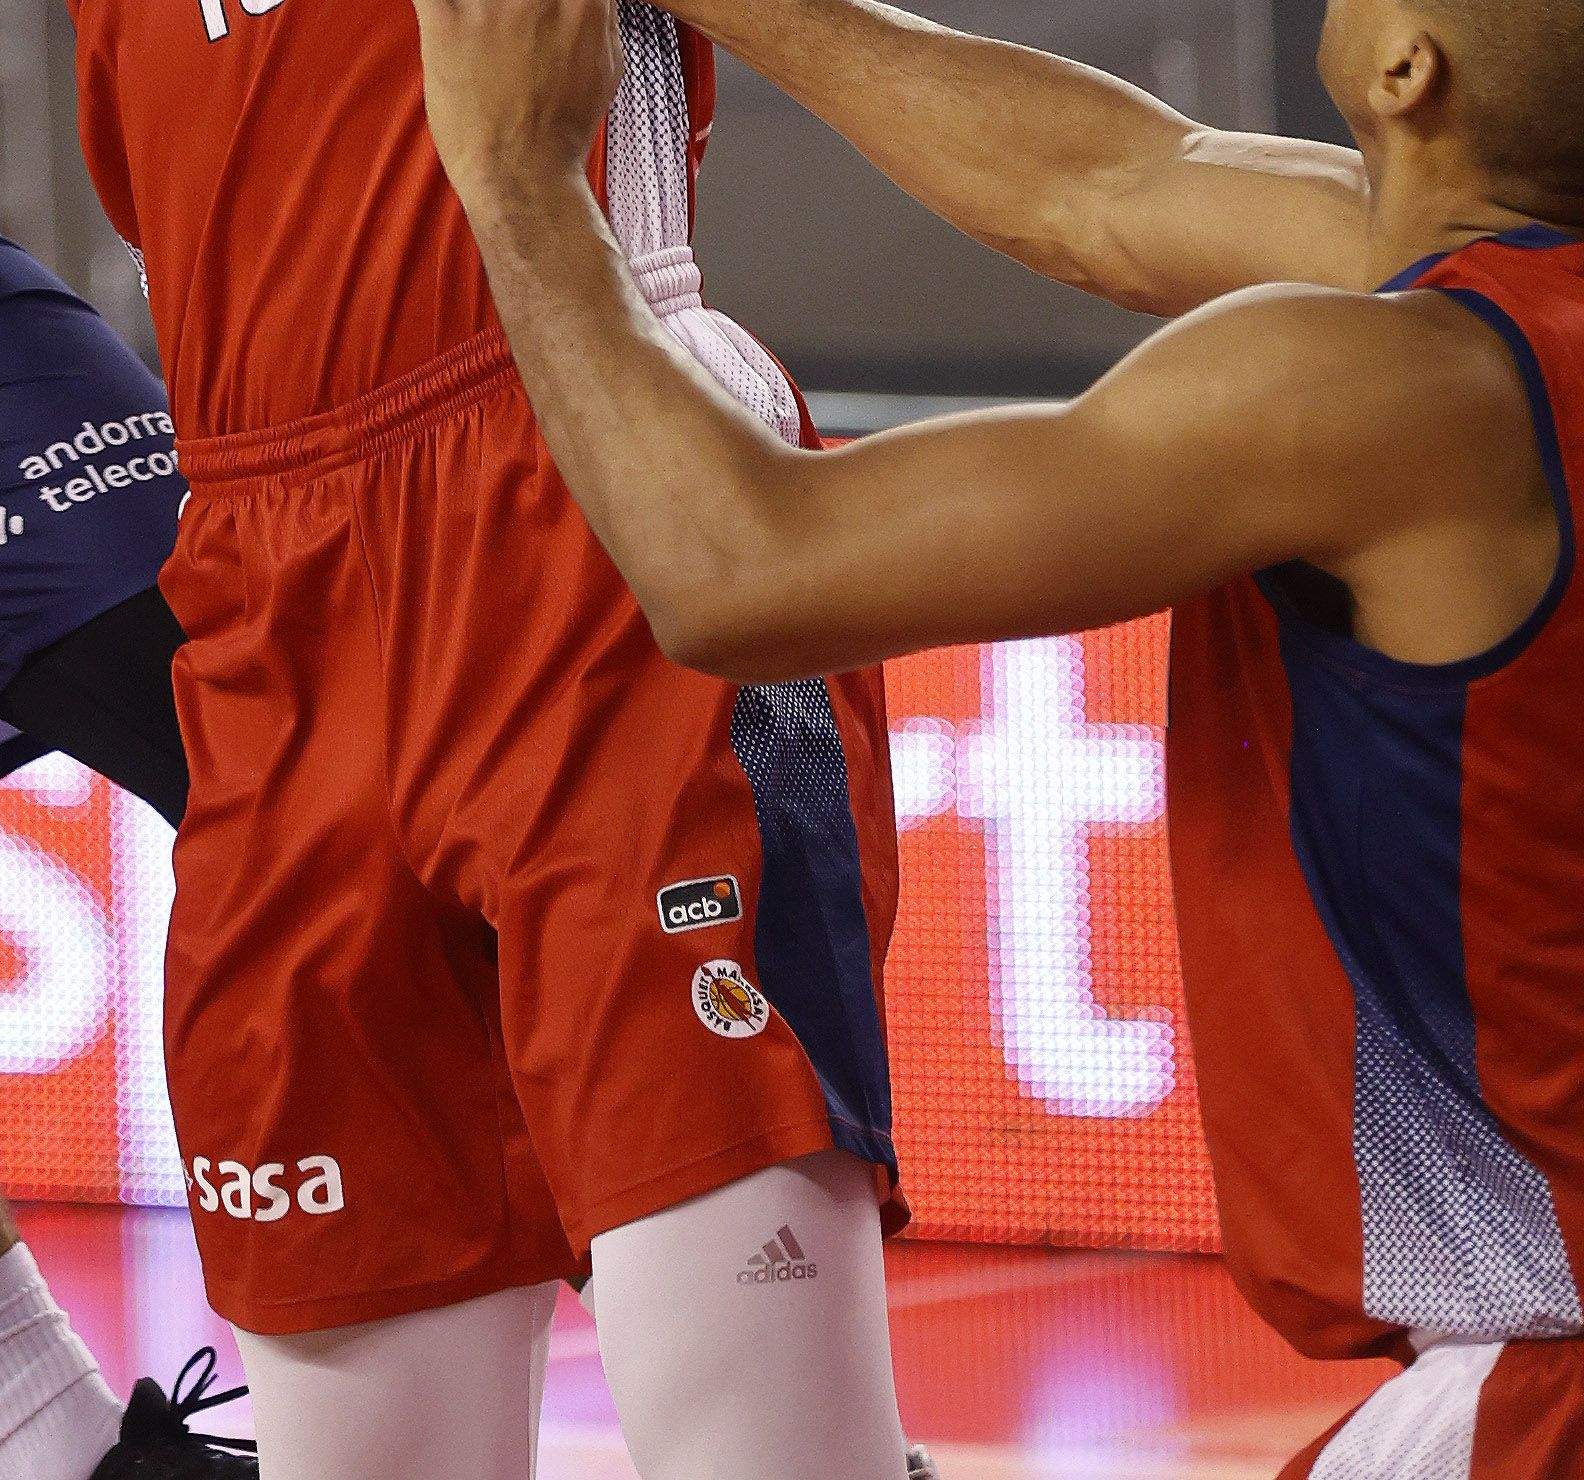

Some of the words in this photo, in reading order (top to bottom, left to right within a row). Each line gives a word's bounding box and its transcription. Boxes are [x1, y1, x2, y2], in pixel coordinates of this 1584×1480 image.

[18, 410, 176, 480] andorra
[38, 448, 180, 512] teleco
[668, 896, 722, 924] acb
[735, 1262, 819, 1285] adidas
